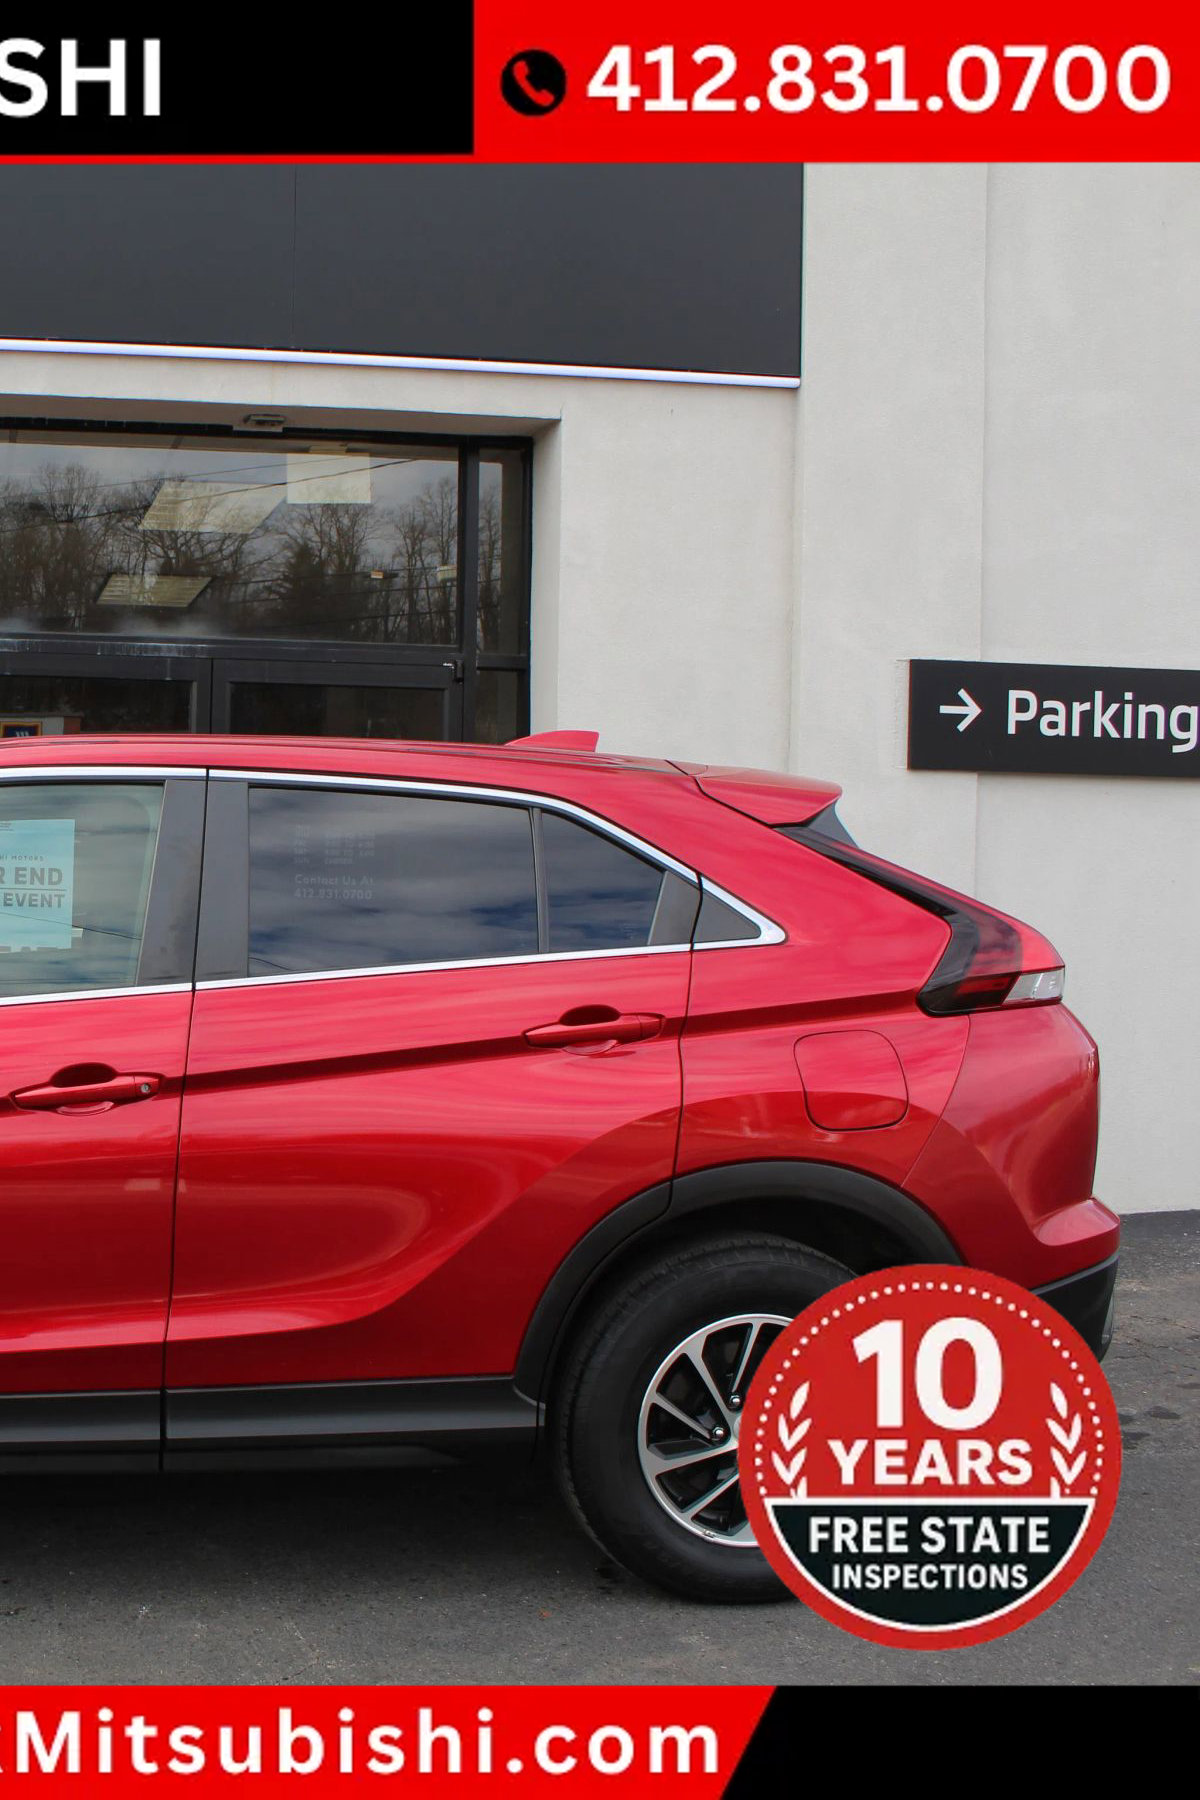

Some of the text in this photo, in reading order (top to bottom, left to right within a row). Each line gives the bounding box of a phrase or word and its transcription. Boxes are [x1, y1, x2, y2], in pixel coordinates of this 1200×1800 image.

[1007, 689, 1199, 754] Parking
[14, 867, 63, 886] END
[3, 892, 66, 909] EVENT
